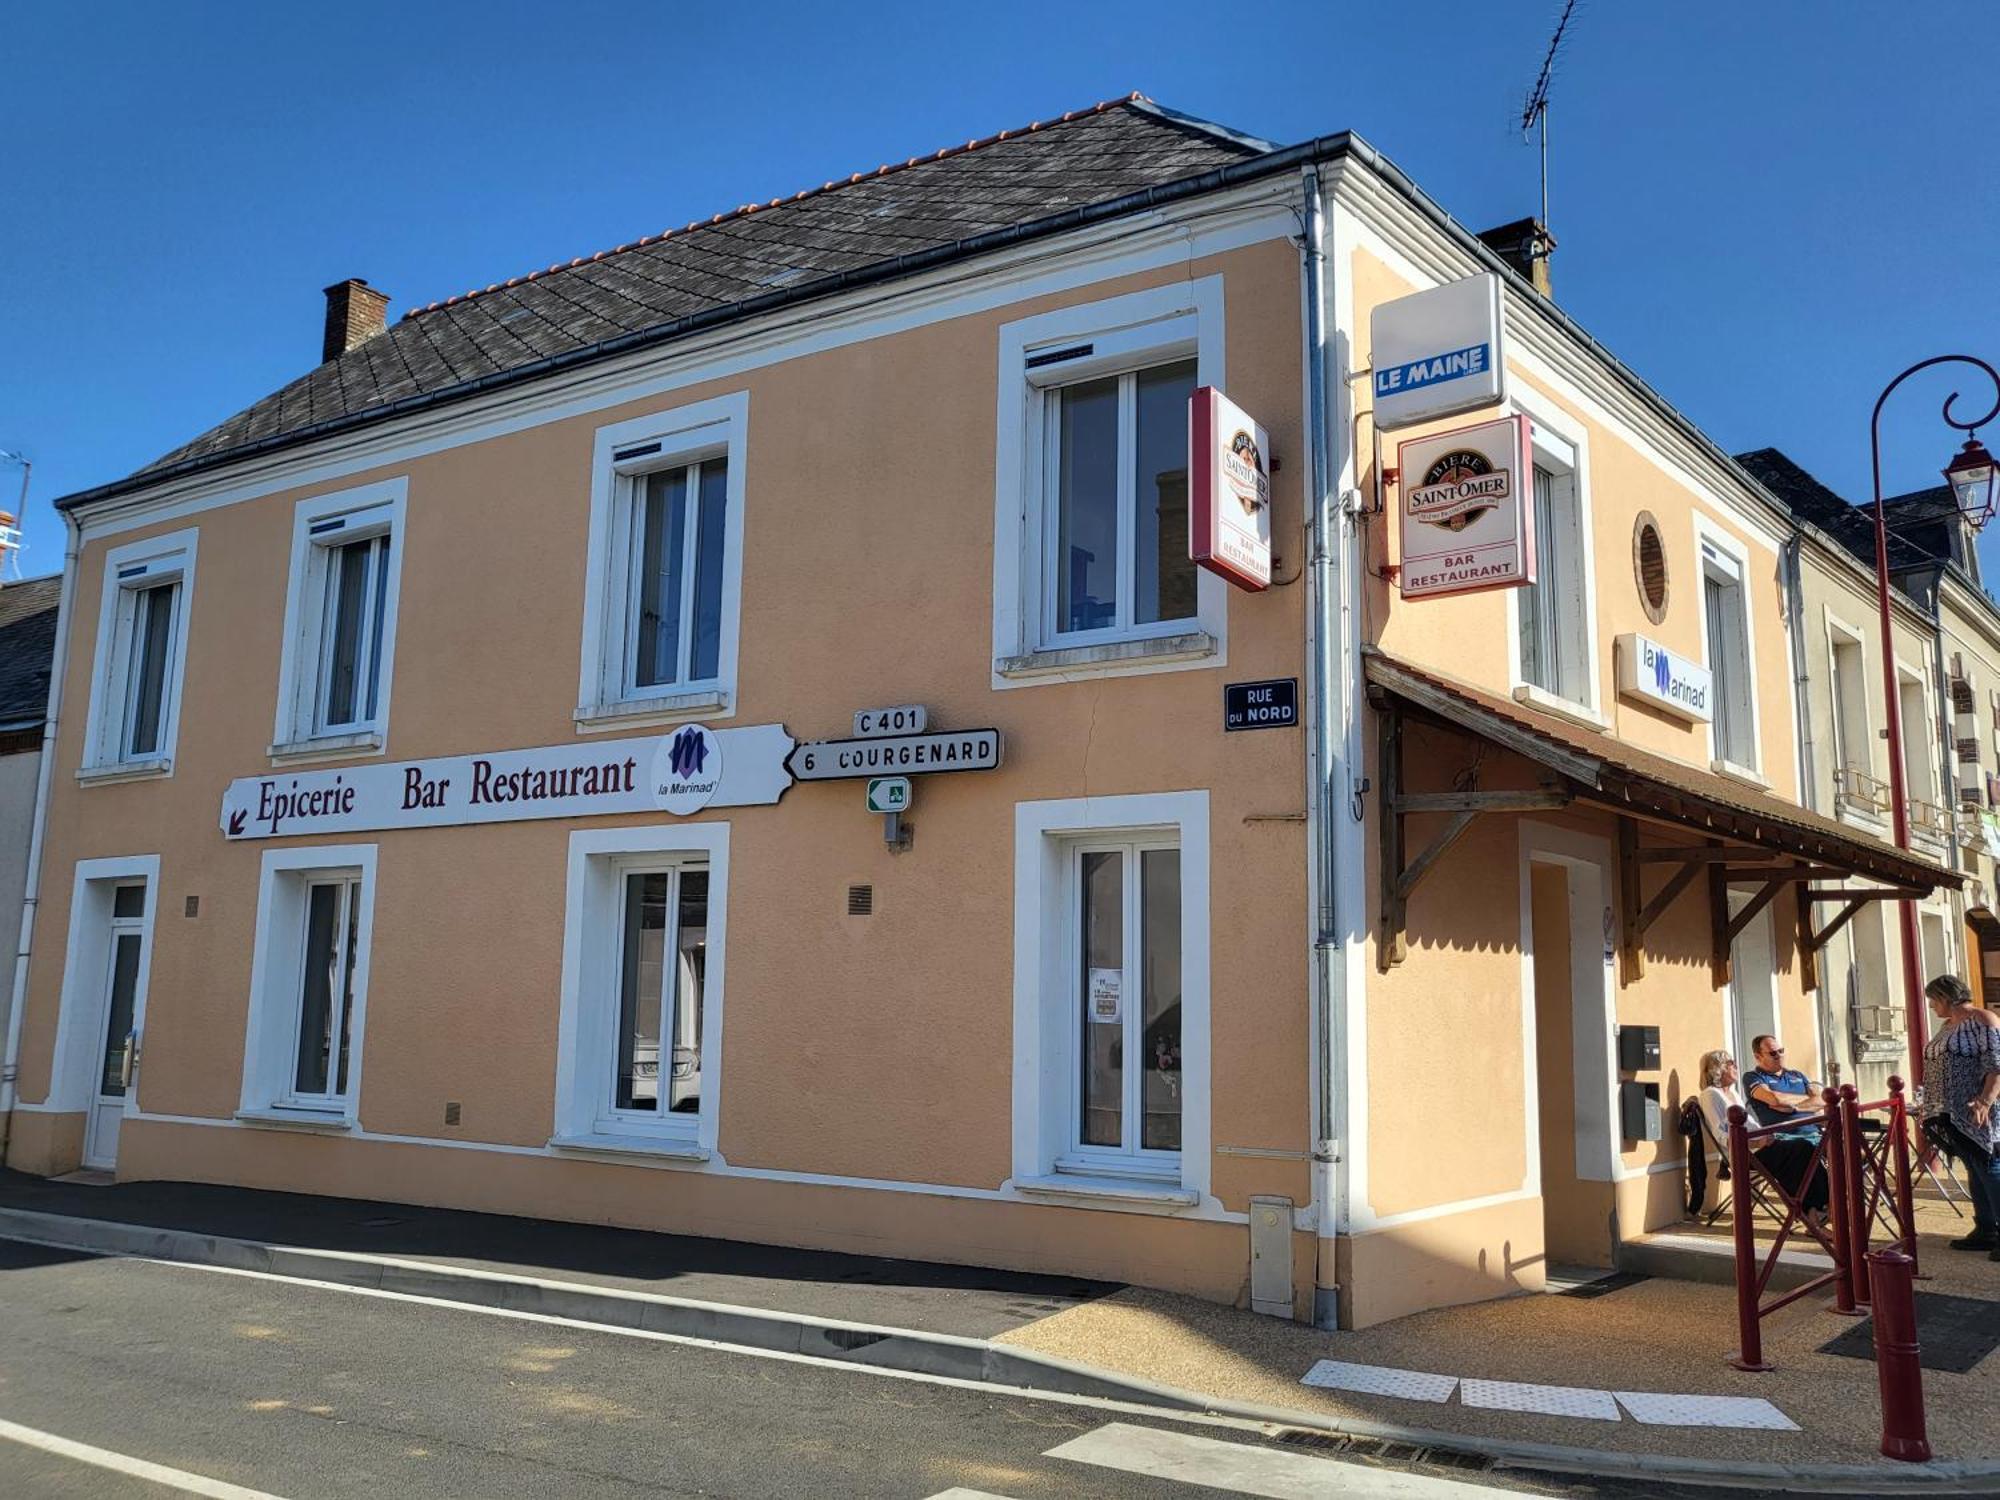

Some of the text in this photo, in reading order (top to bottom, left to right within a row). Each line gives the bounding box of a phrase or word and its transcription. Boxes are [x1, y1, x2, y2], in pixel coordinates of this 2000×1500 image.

[1378, 347, 1482, 391] LE MAINE
[1444, 554, 1475, 568] BAR
[1411, 563, 1511, 587] RESTAURANT
[1643, 639, 1654, 668] la
[1247, 688, 1273, 704] RUE
[860, 710, 916, 733] C 401
[1229, 706, 1292, 724] DU NORD
[804, 740, 990, 771] 6 COURGENARD
[256, 756, 637, 834] Epicerie Bar Restaurant
[658, 783, 668, 796] la
